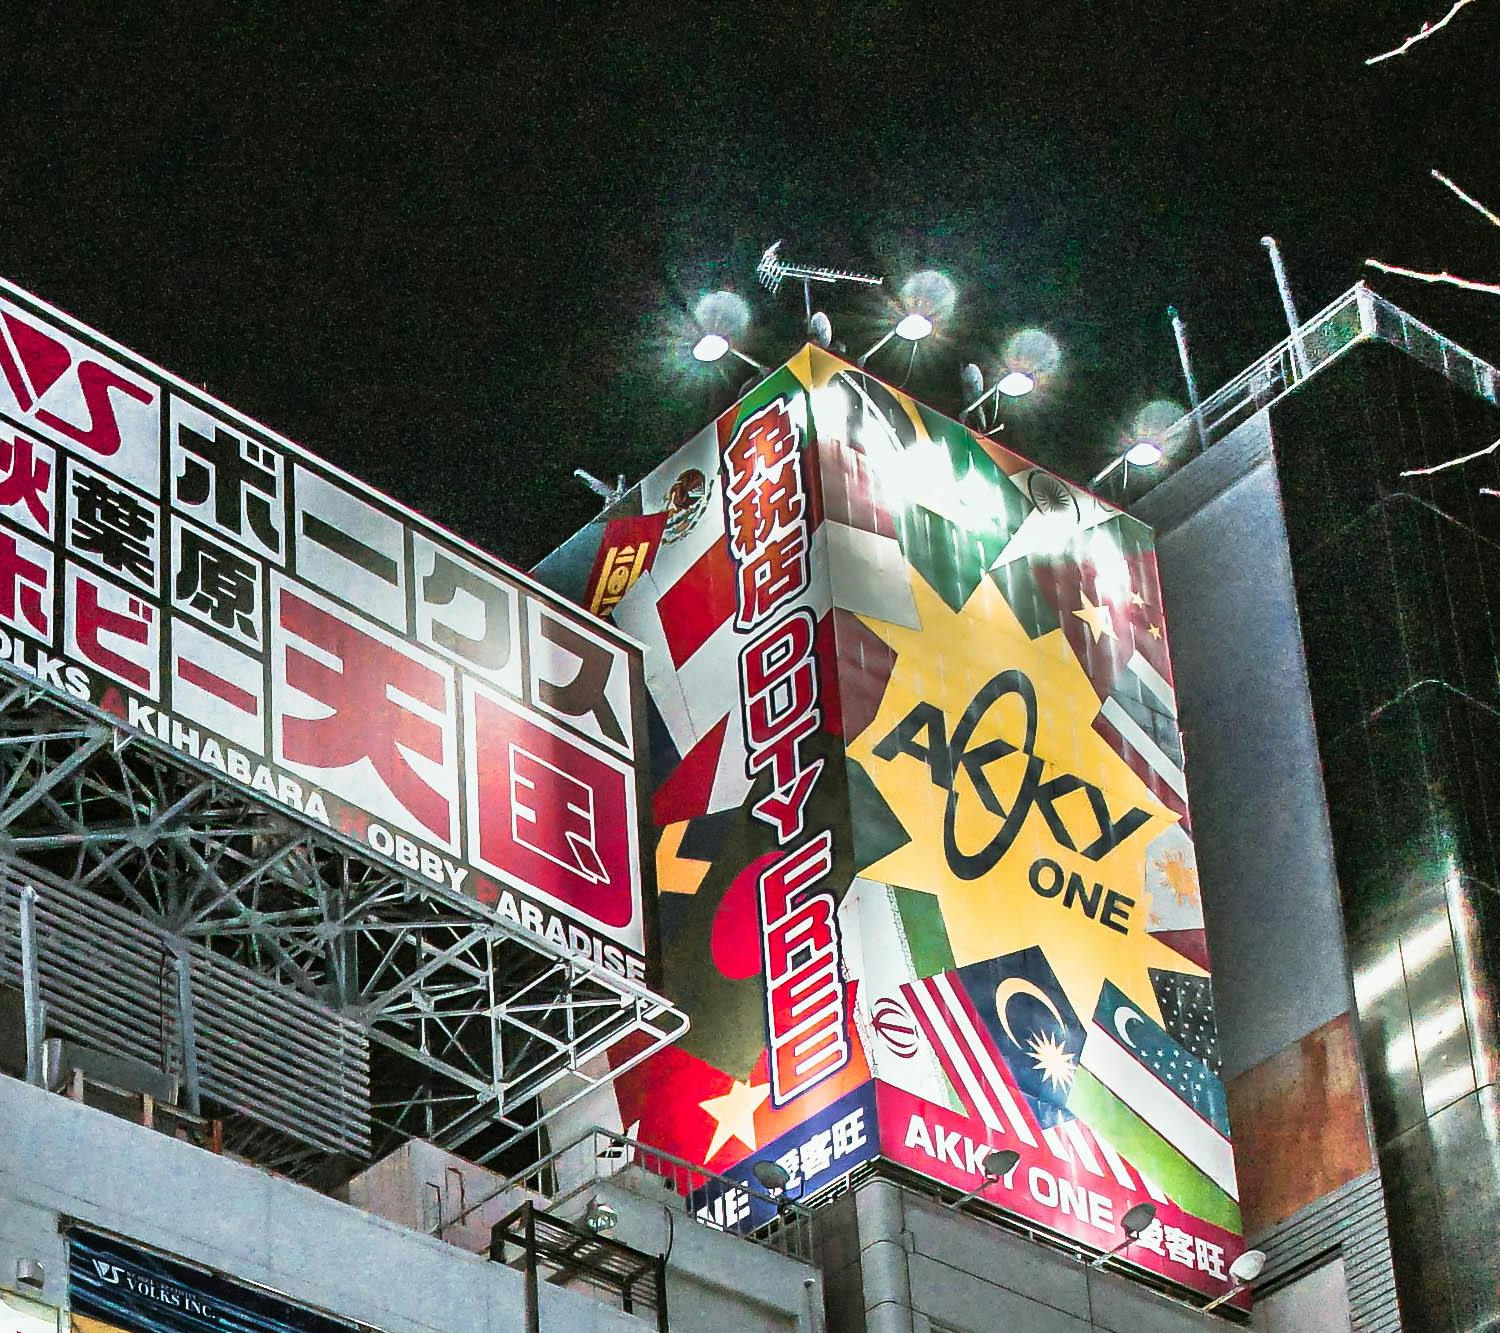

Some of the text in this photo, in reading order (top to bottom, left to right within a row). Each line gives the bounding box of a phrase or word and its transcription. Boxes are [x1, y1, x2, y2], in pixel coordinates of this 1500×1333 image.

[729, 398, 808, 626] 免税店
[100, 686, 330, 827] AKIHABARA
[339, 805, 470, 897] HOBBY
[477, 877, 646, 992] PARADISE
[744, 617, 850, 1107] DUTY FREE
[873, 678, 1152, 875] AKKY
[1028, 853, 1139, 935] ONE
[126, 1275, 180, 1306] VOLKS
[183, 1296, 218, 1321] INC.
[1027, 1165, 1117, 1236] ONE
